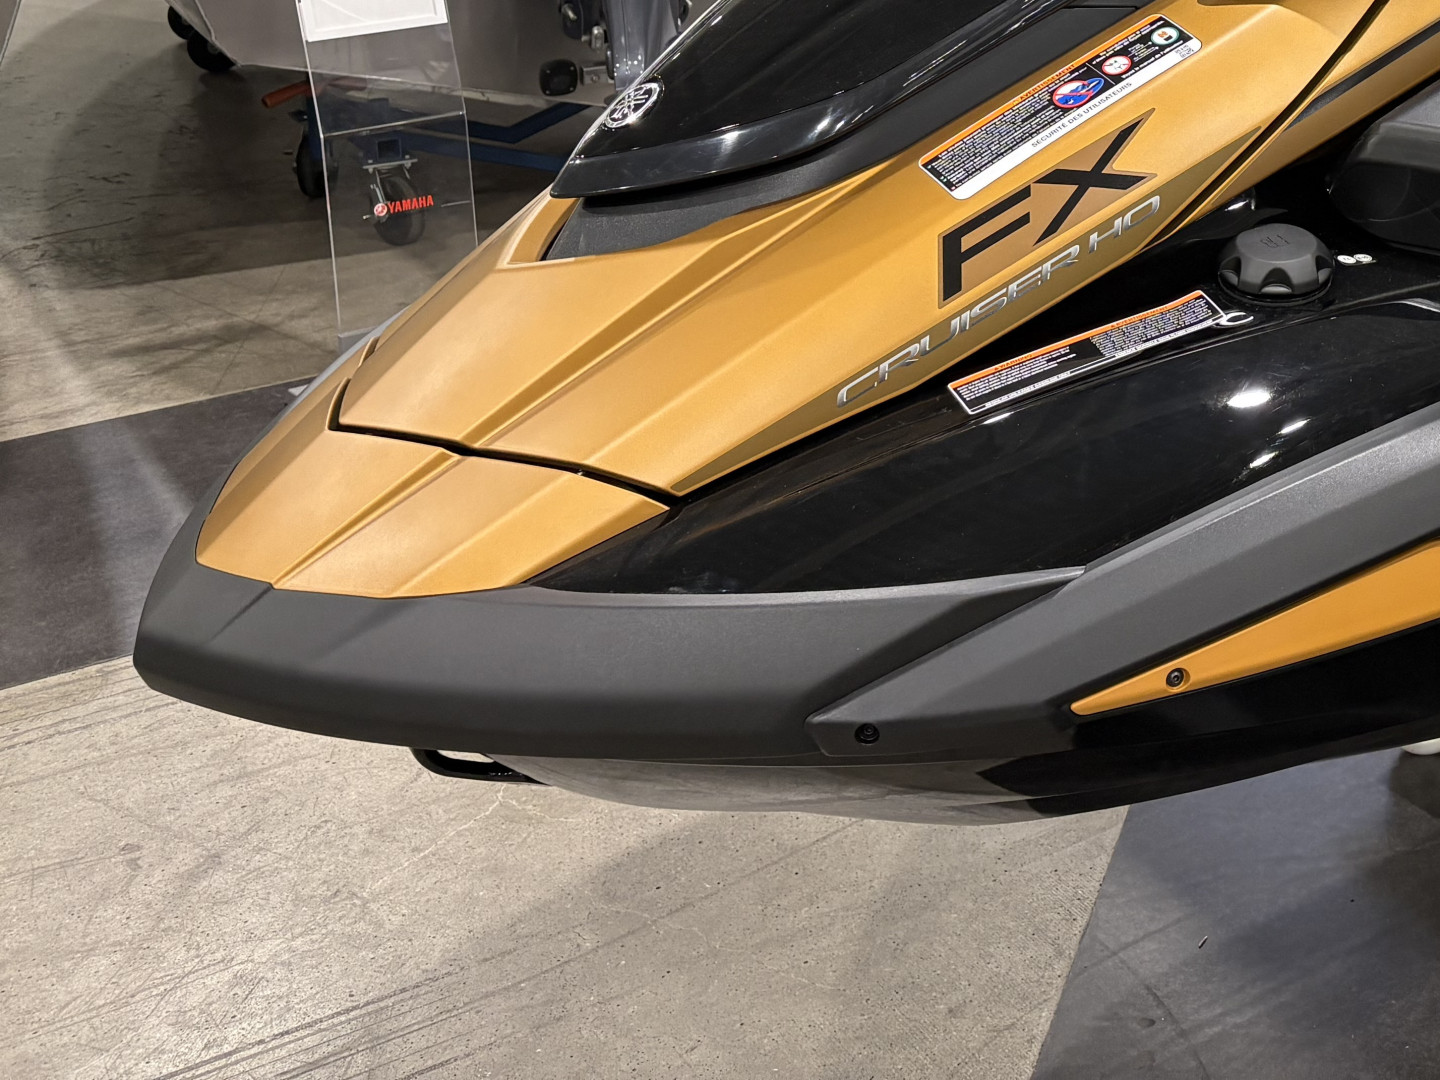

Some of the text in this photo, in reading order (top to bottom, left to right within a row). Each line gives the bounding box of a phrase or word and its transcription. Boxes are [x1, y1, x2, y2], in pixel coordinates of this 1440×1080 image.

[1031, 81, 1133, 149] SÉCURITÉ DES UTILISATEURS
[387, 194, 434, 214] YAMAHA
[941, 110, 1154, 303] FX
[837, 244, 1080, 409] CRUISER
[1088, 194, 1160, 254] HO
